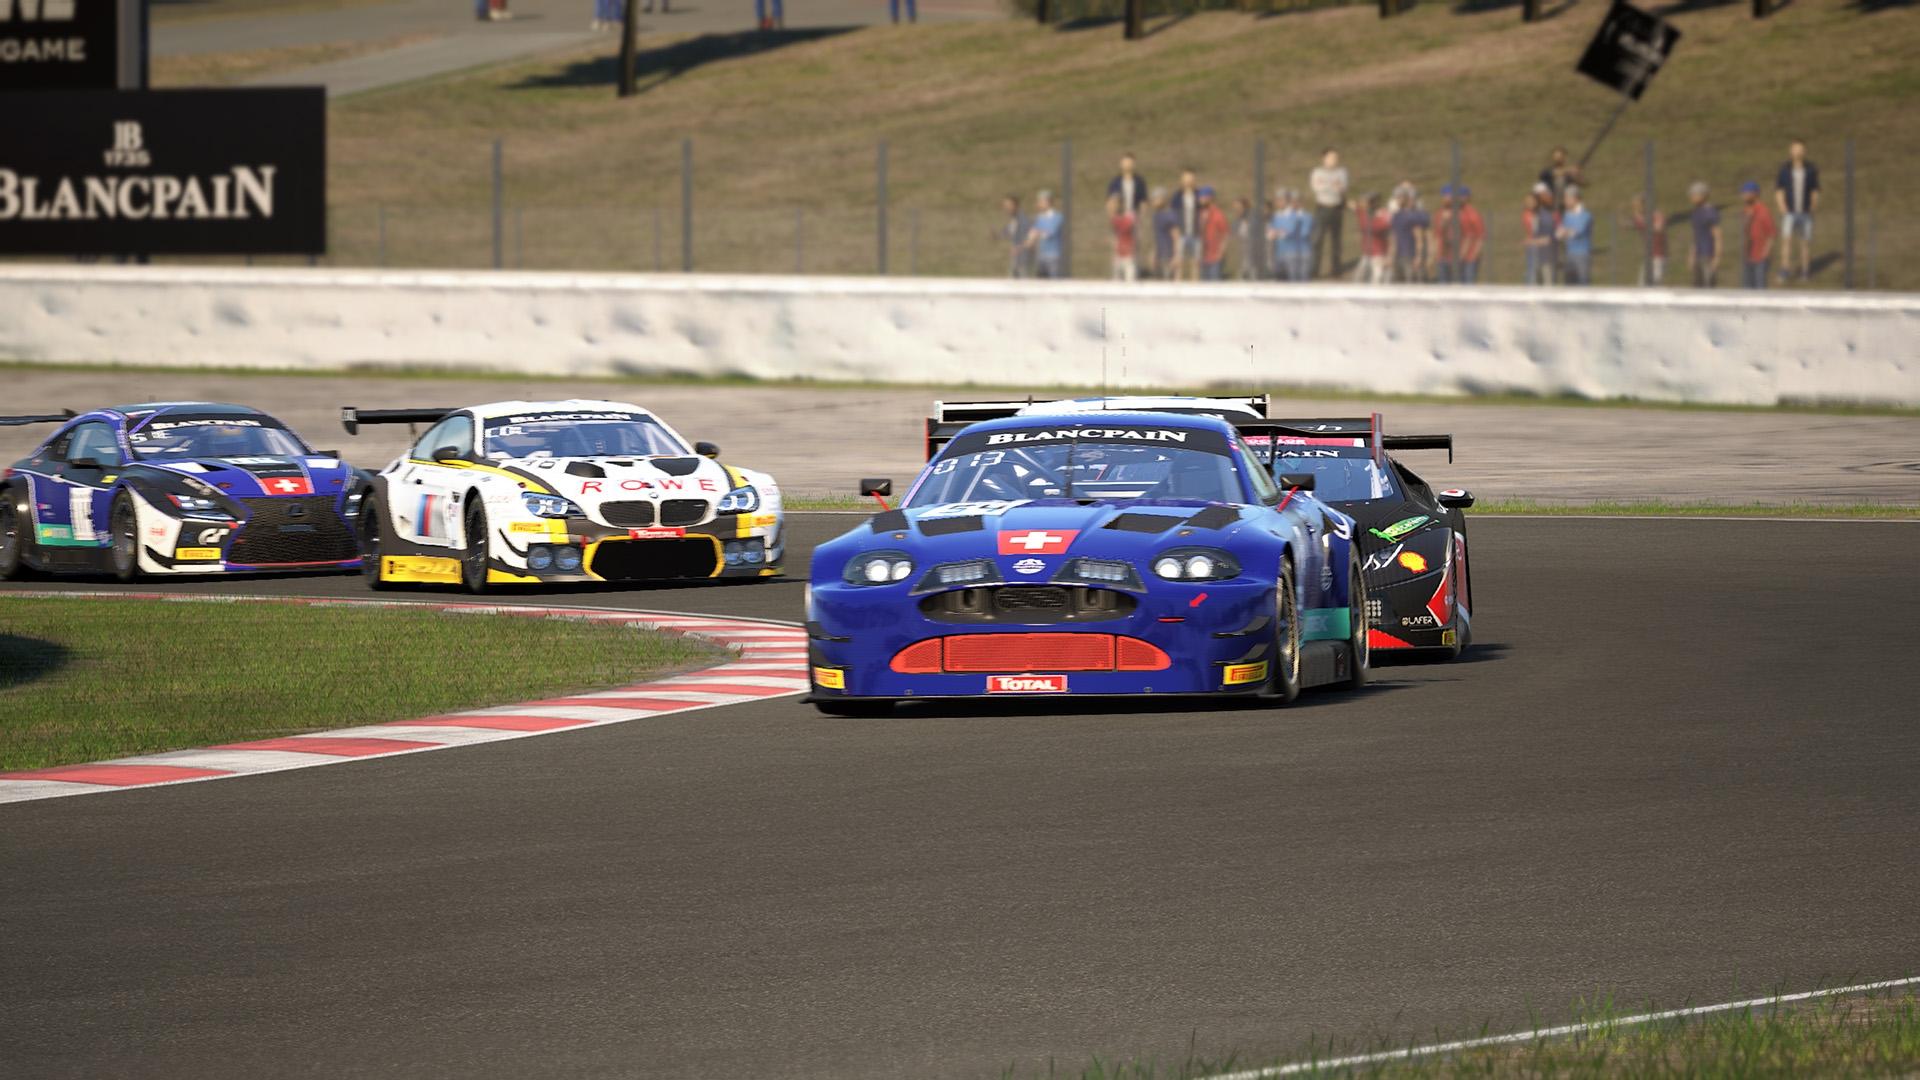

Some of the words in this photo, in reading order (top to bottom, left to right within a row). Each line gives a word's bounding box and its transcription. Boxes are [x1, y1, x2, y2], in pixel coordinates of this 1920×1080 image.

[0, 166, 276, 220] BLANCPAIN
[986, 429, 1188, 446] BLANCPAIN
[580, 478, 717, 495] ROWE
[996, 677, 1058, 691] TOTAL
